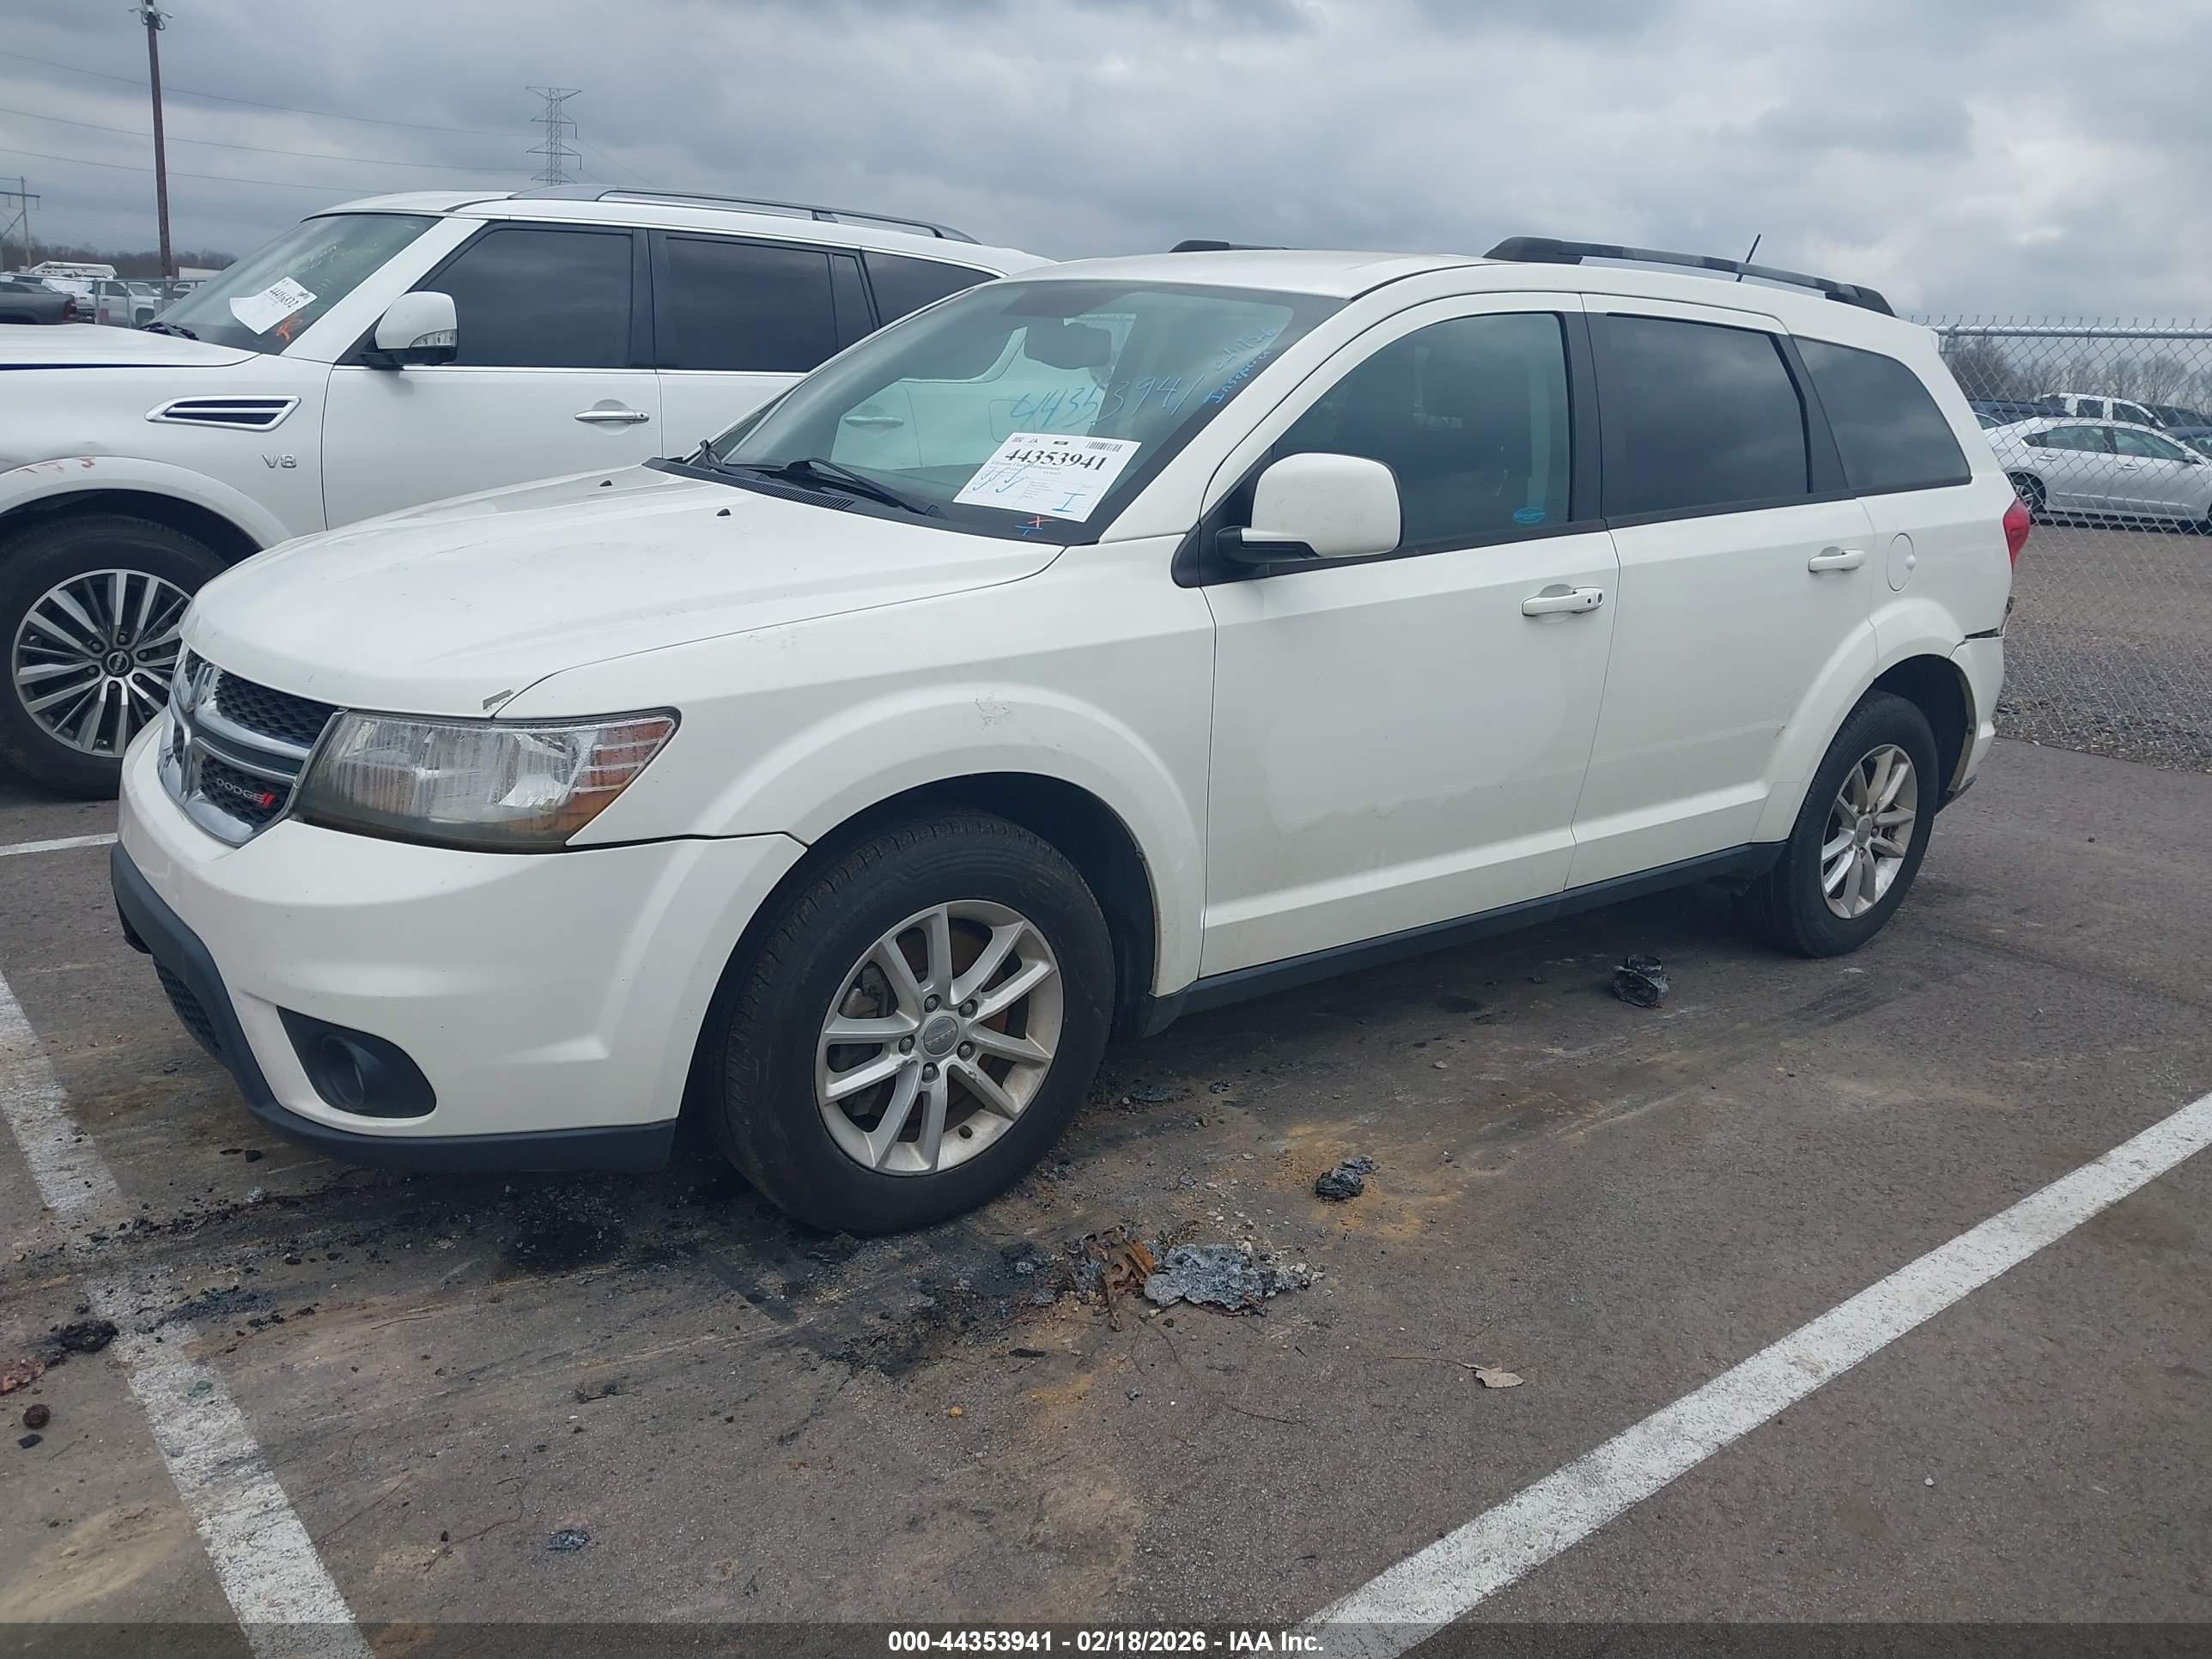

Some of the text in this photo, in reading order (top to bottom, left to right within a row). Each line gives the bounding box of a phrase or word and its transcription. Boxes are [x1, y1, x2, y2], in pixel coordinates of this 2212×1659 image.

[262, 453, 297, 469] V8
[1005, 447, 1109, 471] 44353941
[216, 777, 264, 804] DODGE
